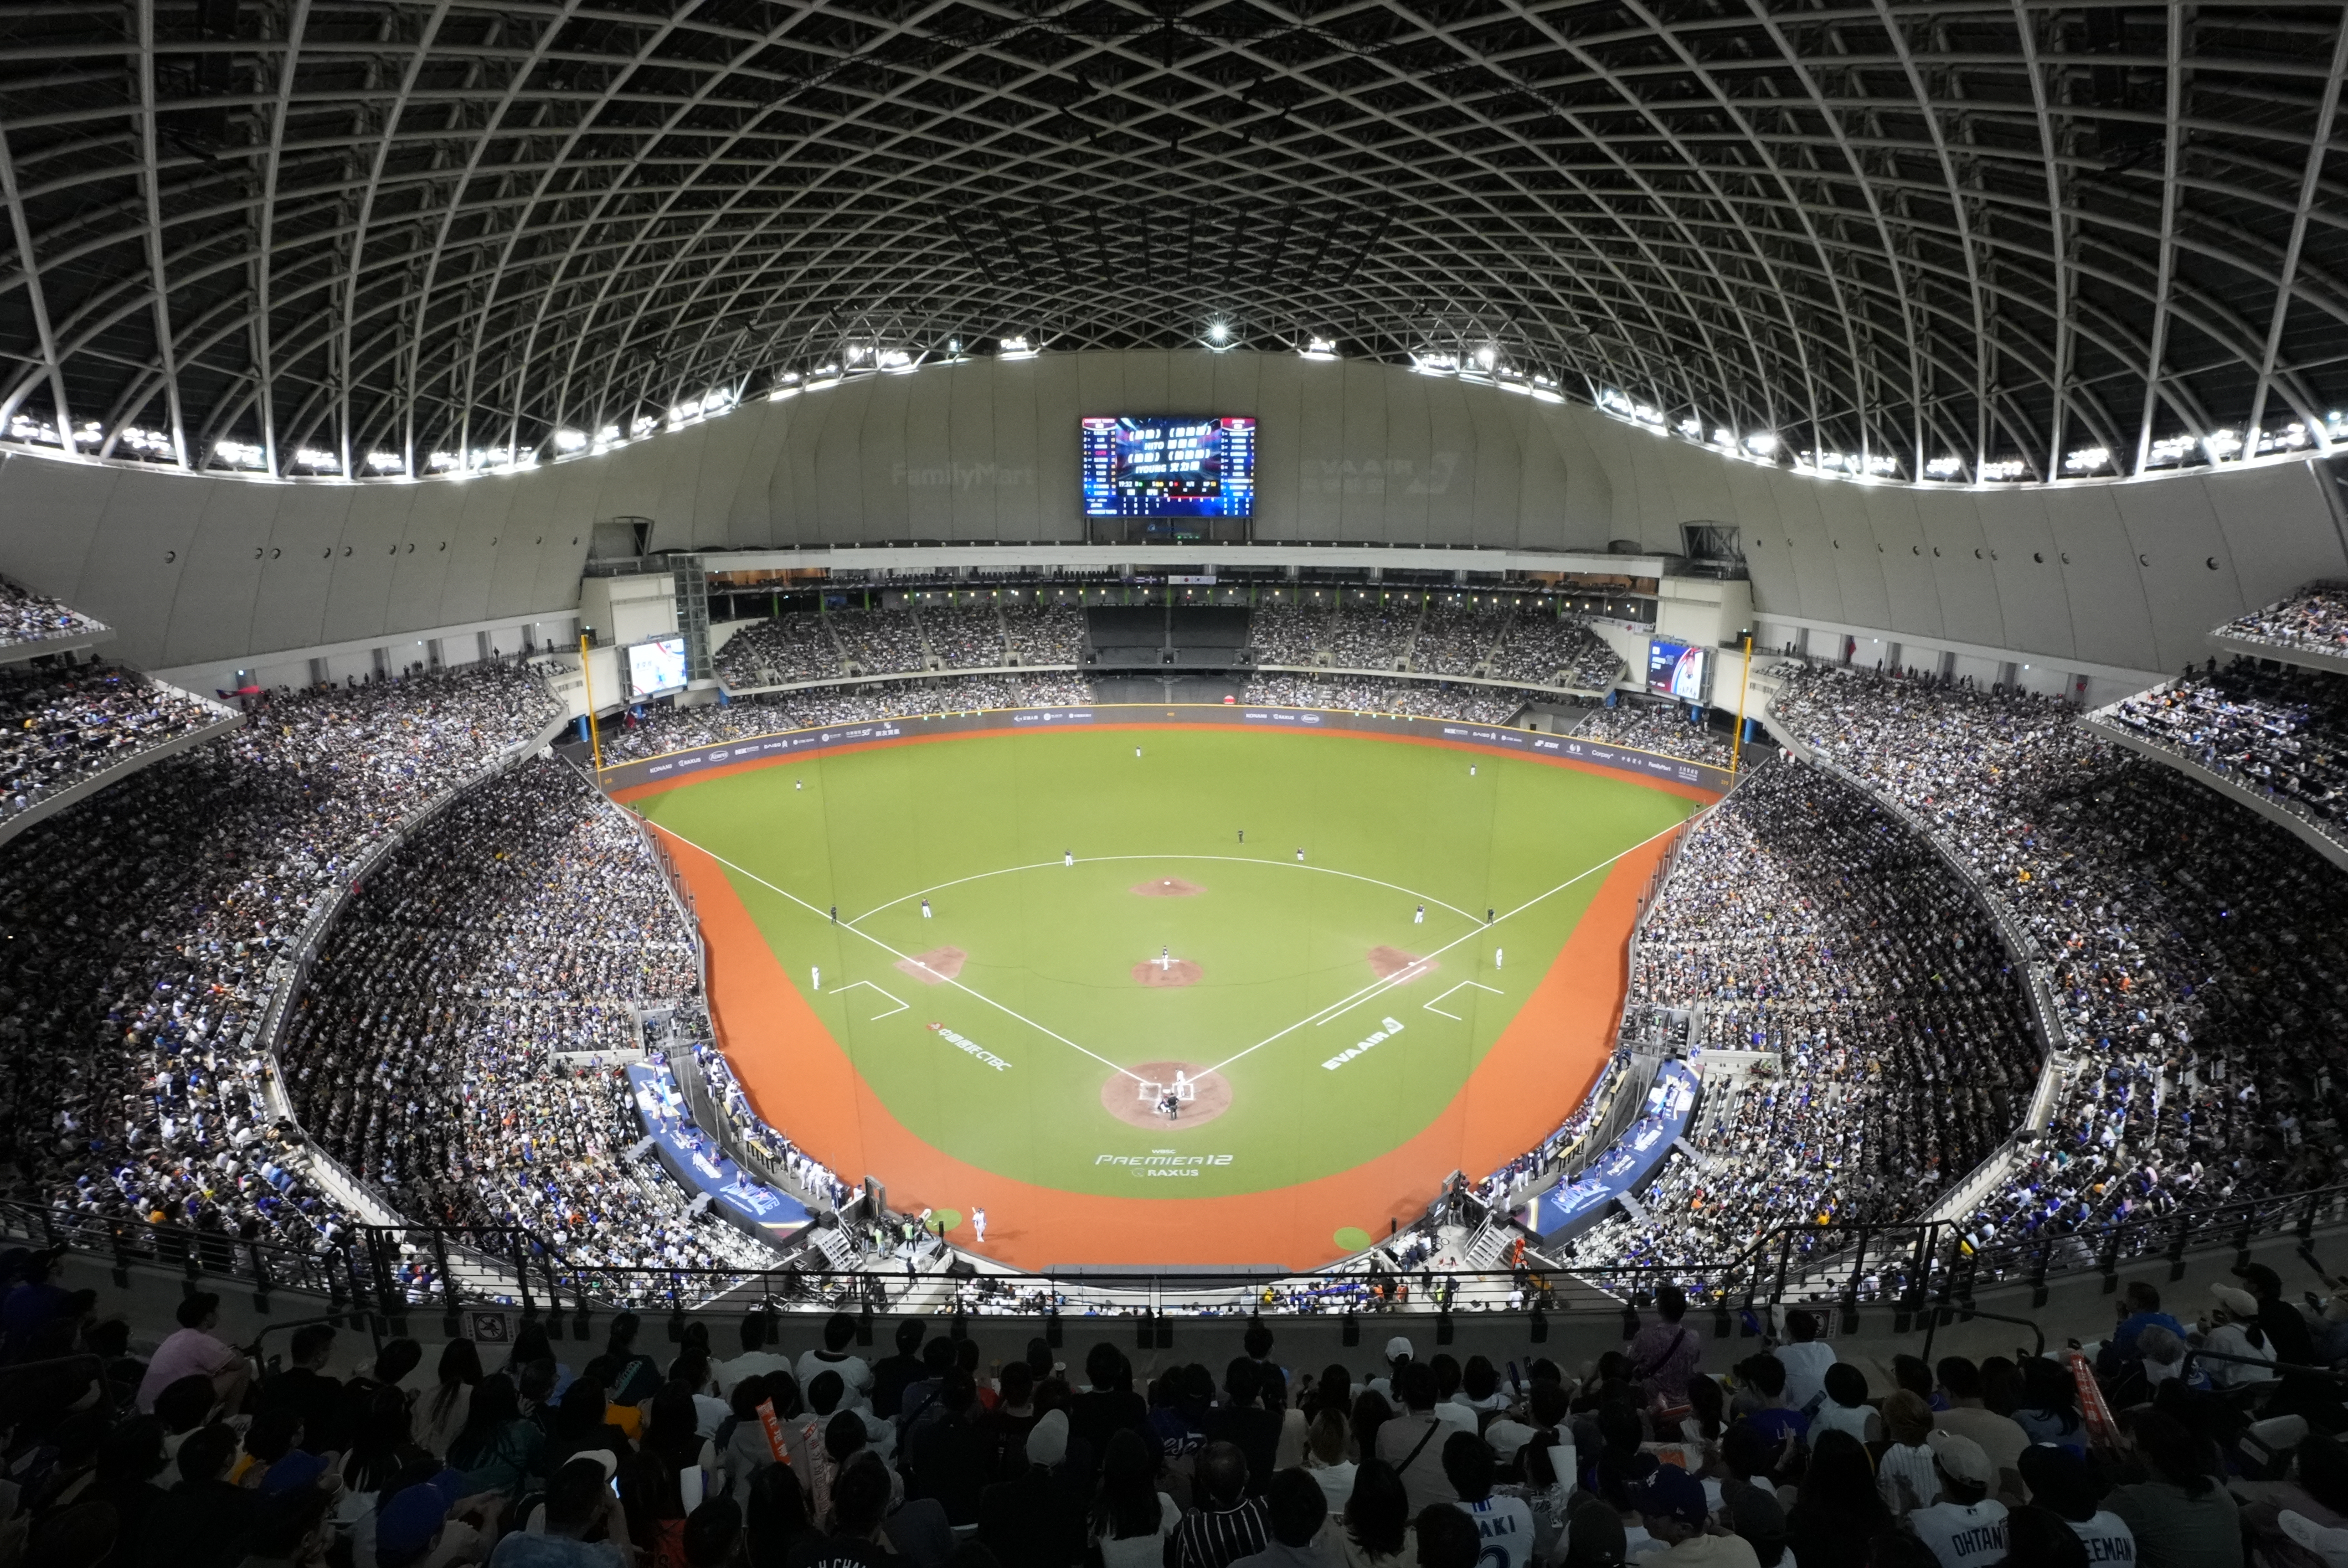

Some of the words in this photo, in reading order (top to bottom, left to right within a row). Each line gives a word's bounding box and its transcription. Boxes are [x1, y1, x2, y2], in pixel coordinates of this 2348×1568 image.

[1144, 441, 1165, 450] HITO
[684, 757, 701, 766] RAXUS
[1592, 750, 1612, 759] Corpay
[650, 764, 672, 773] KONAMI
[1648, 761, 1671, 771] FamilyMart
[1321, 1049, 1363, 1070] EVA
[1357, 1031, 1389, 1051] AIR
[976, 1051, 1012, 1071] CTBC
[1480, 1515, 1516, 1539] AKI
[1952, 1526, 2005, 1557] OHTAN
[2082, 1538, 2132, 1562] EEMAN
